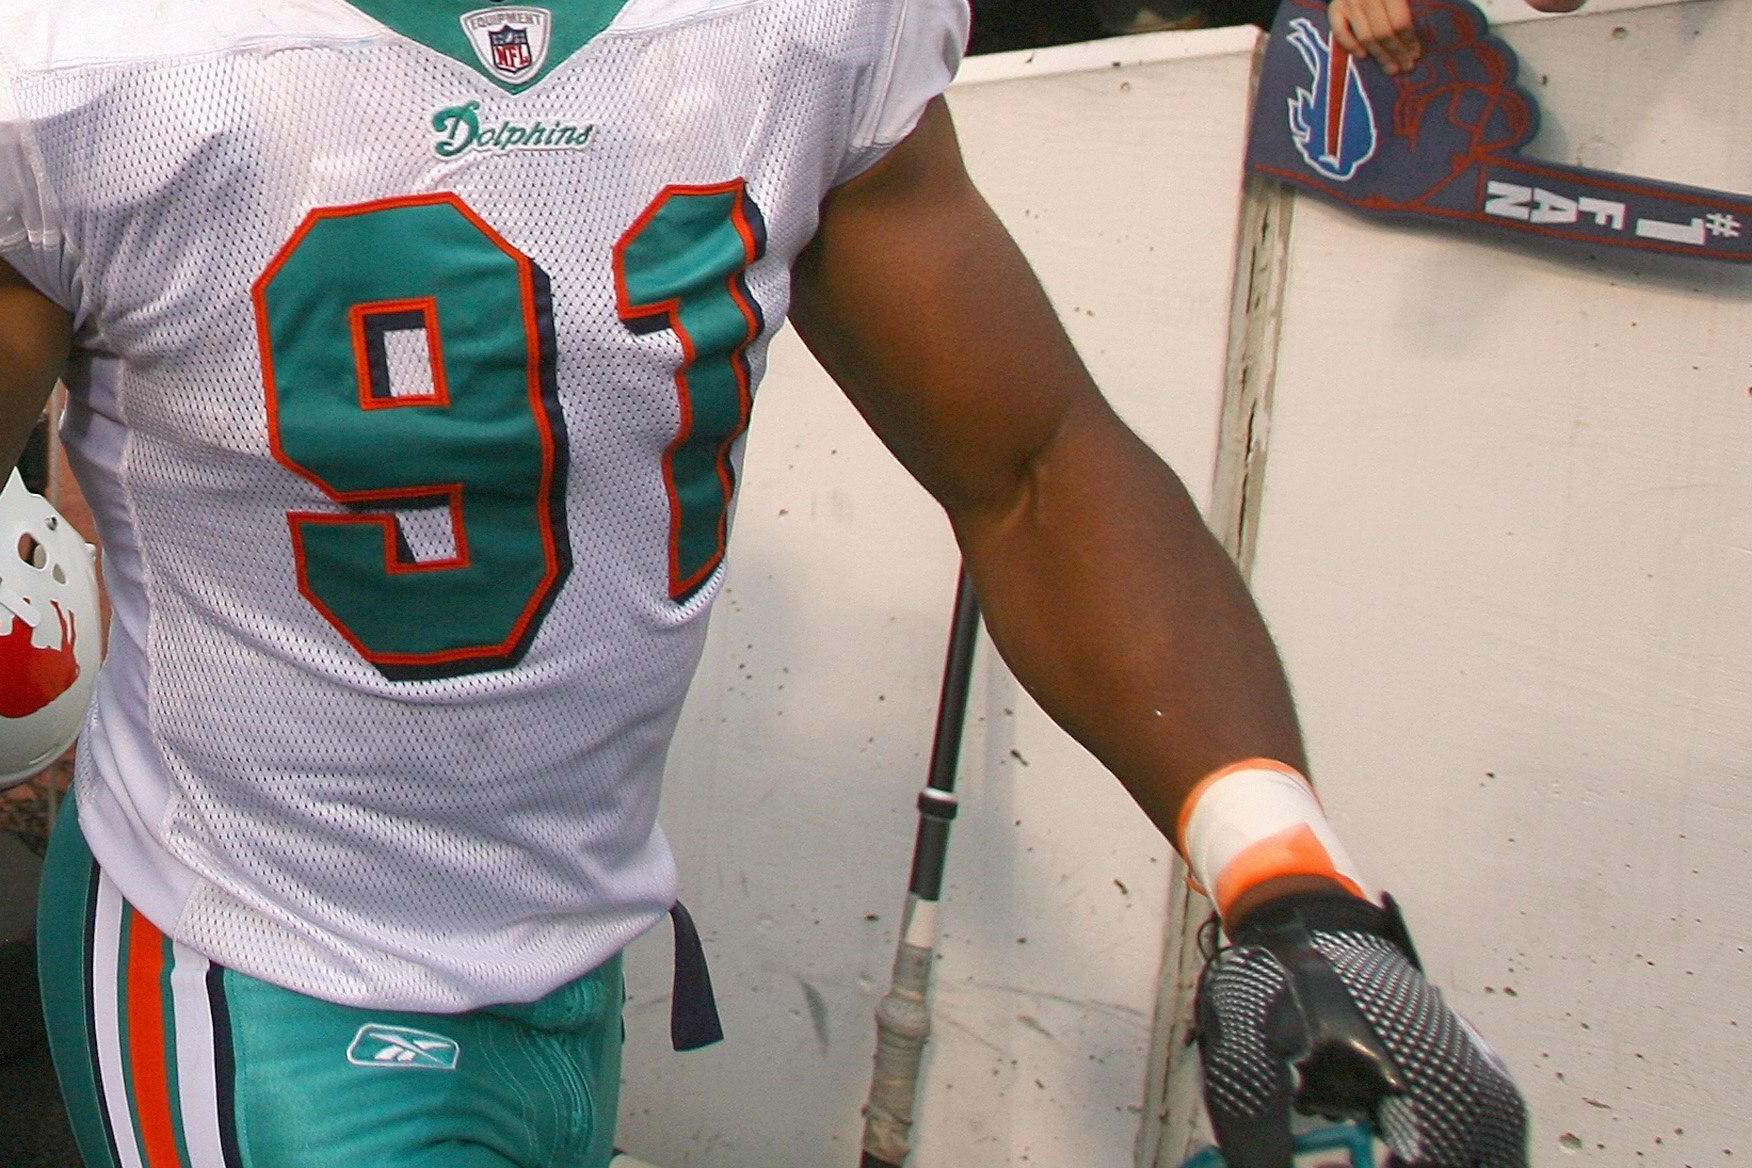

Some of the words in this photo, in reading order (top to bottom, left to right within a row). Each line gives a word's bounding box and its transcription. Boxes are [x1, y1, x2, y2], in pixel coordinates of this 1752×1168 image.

[470, 13, 542, 31] EQUIPMENT
[494, 44, 531, 69] NFL
[431, 99, 593, 157] Dolphins
[1483, 179, 1628, 231] FAN
[252, 177, 766, 682] 91
